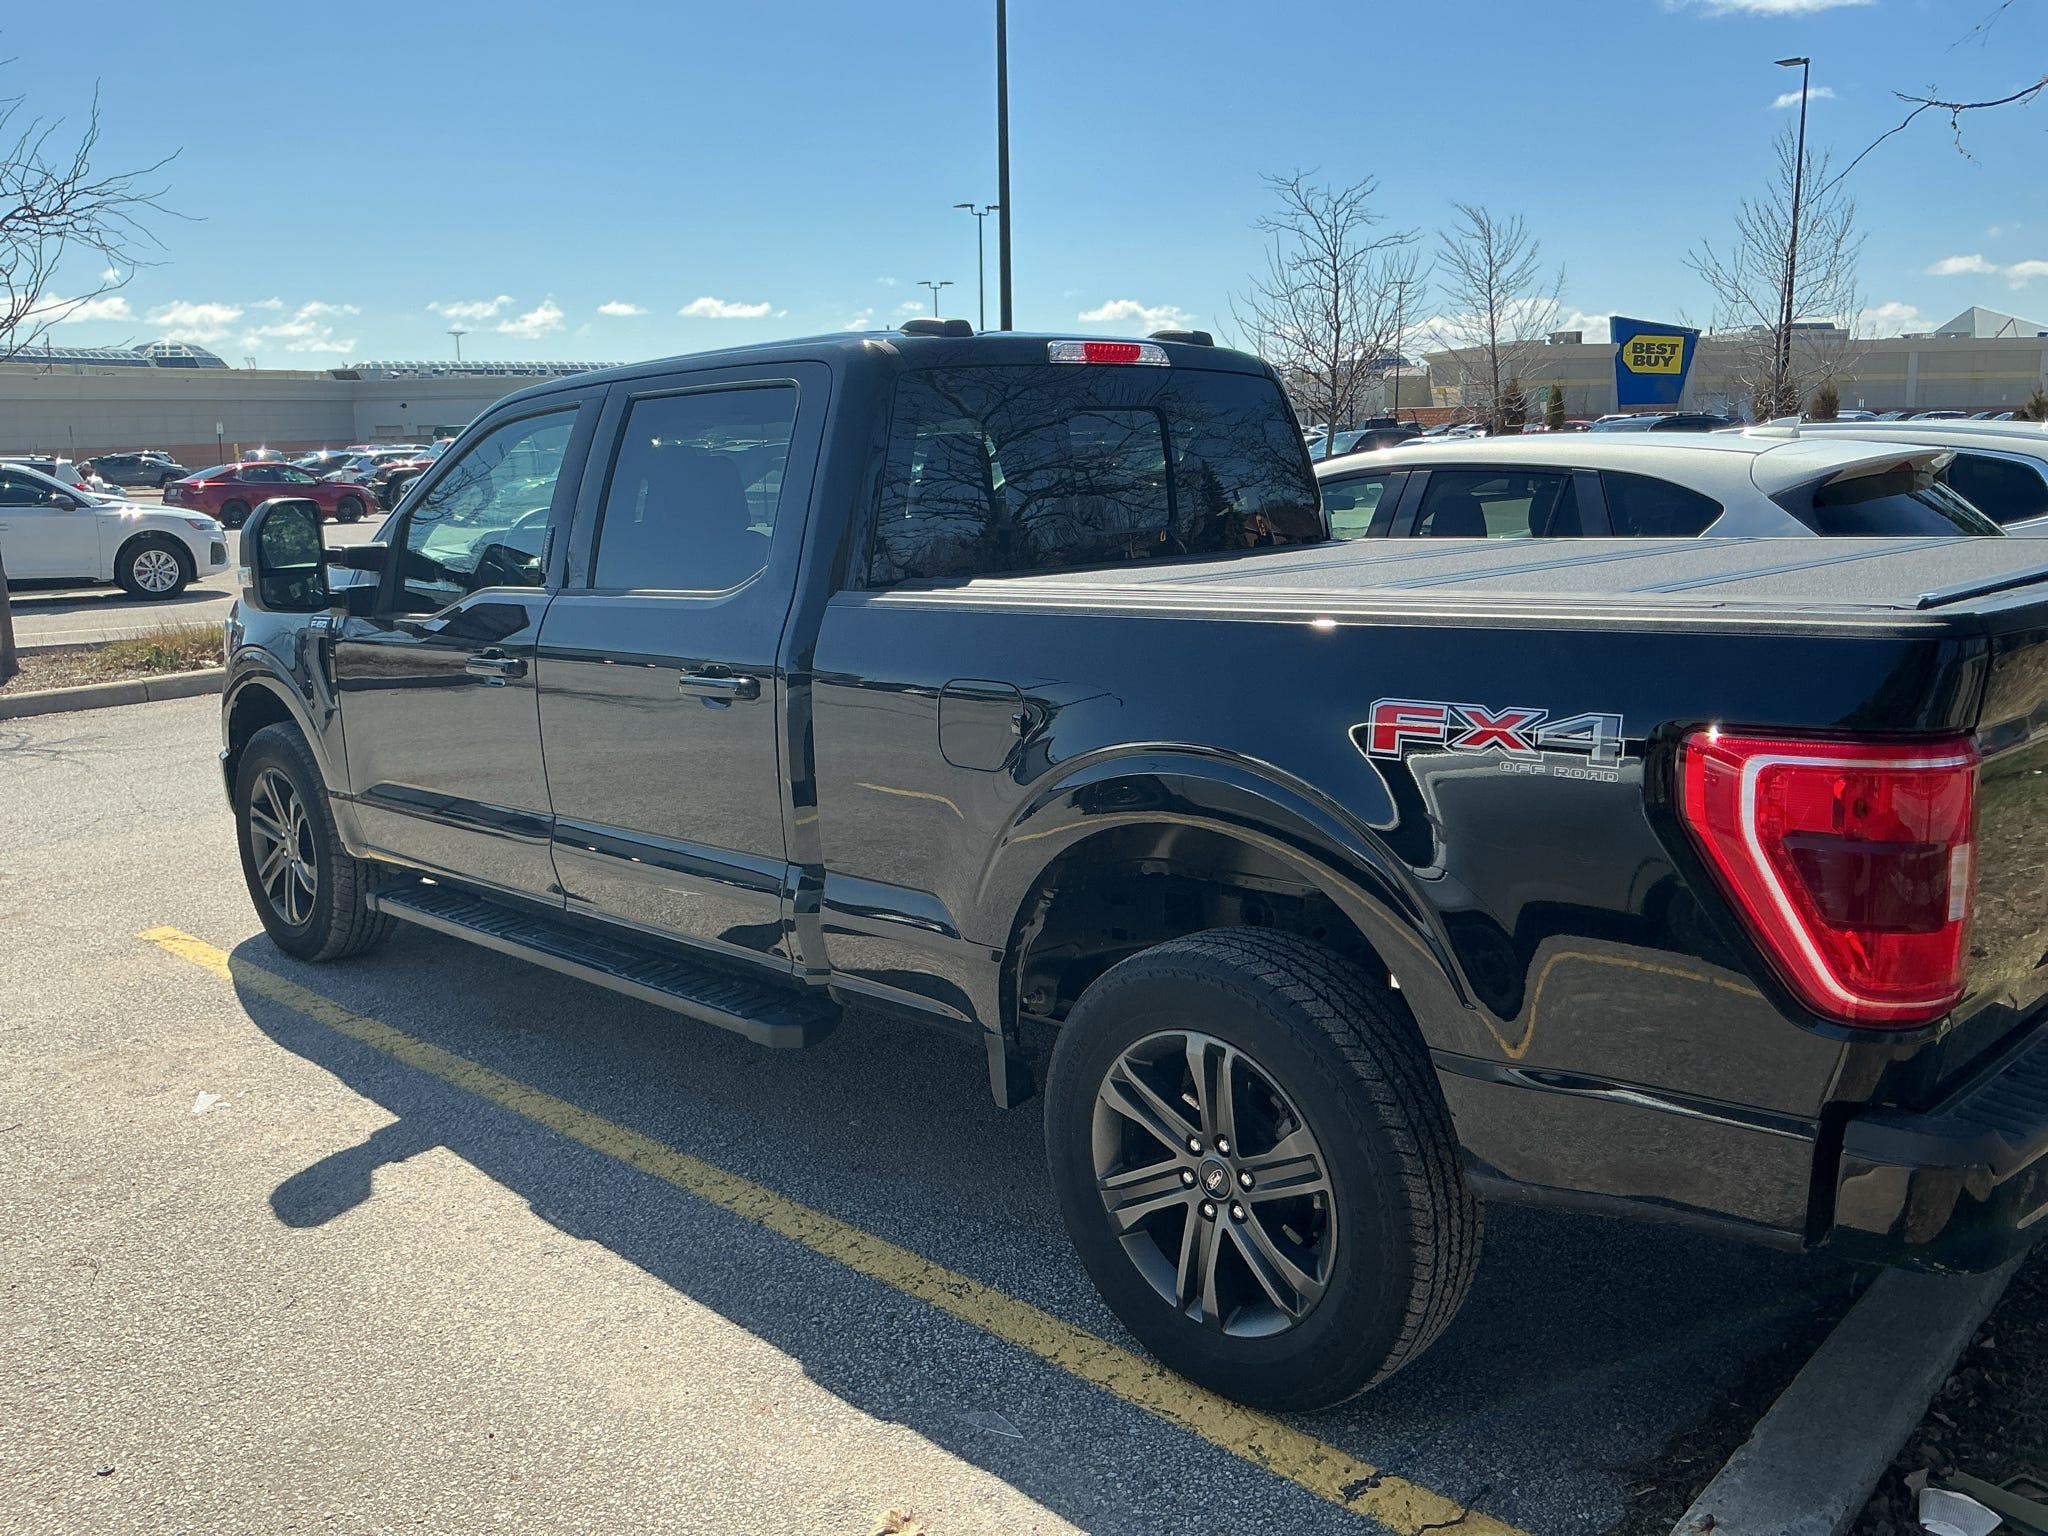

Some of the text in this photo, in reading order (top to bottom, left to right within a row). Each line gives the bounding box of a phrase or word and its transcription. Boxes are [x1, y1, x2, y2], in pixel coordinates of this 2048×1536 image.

[1632, 343, 1679, 355] BEST
[1633, 355, 1673, 367] BUY
[1367, 697, 1625, 769] FX4
[1500, 761, 1619, 783] OFF ROAD
